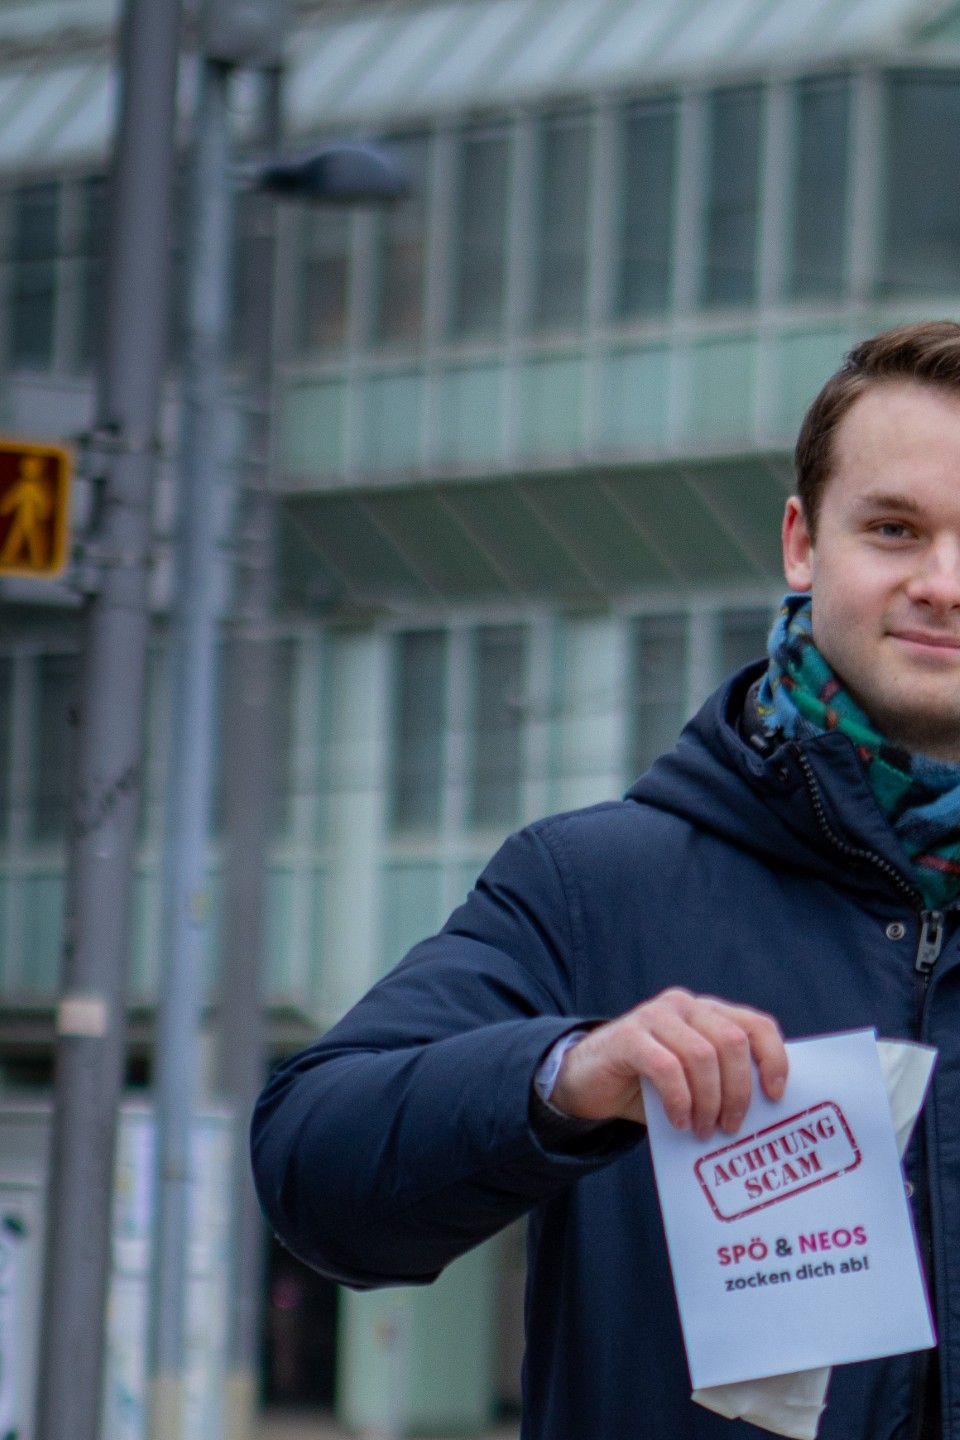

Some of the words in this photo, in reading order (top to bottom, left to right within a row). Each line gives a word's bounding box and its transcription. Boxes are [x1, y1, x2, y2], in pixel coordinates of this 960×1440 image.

[713, 1115, 836, 1187] ACHTUNG
[744, 1151, 822, 1200] SCAM
[717, 1237, 768, 1266] SPÖ
[775, 1238, 793, 1258] &
[798, 1226, 868, 1254] NEOS
[725, 1271, 791, 1292] zocken
[796, 1261, 835, 1281] dich
[840, 1256, 869, 1274] ab!
